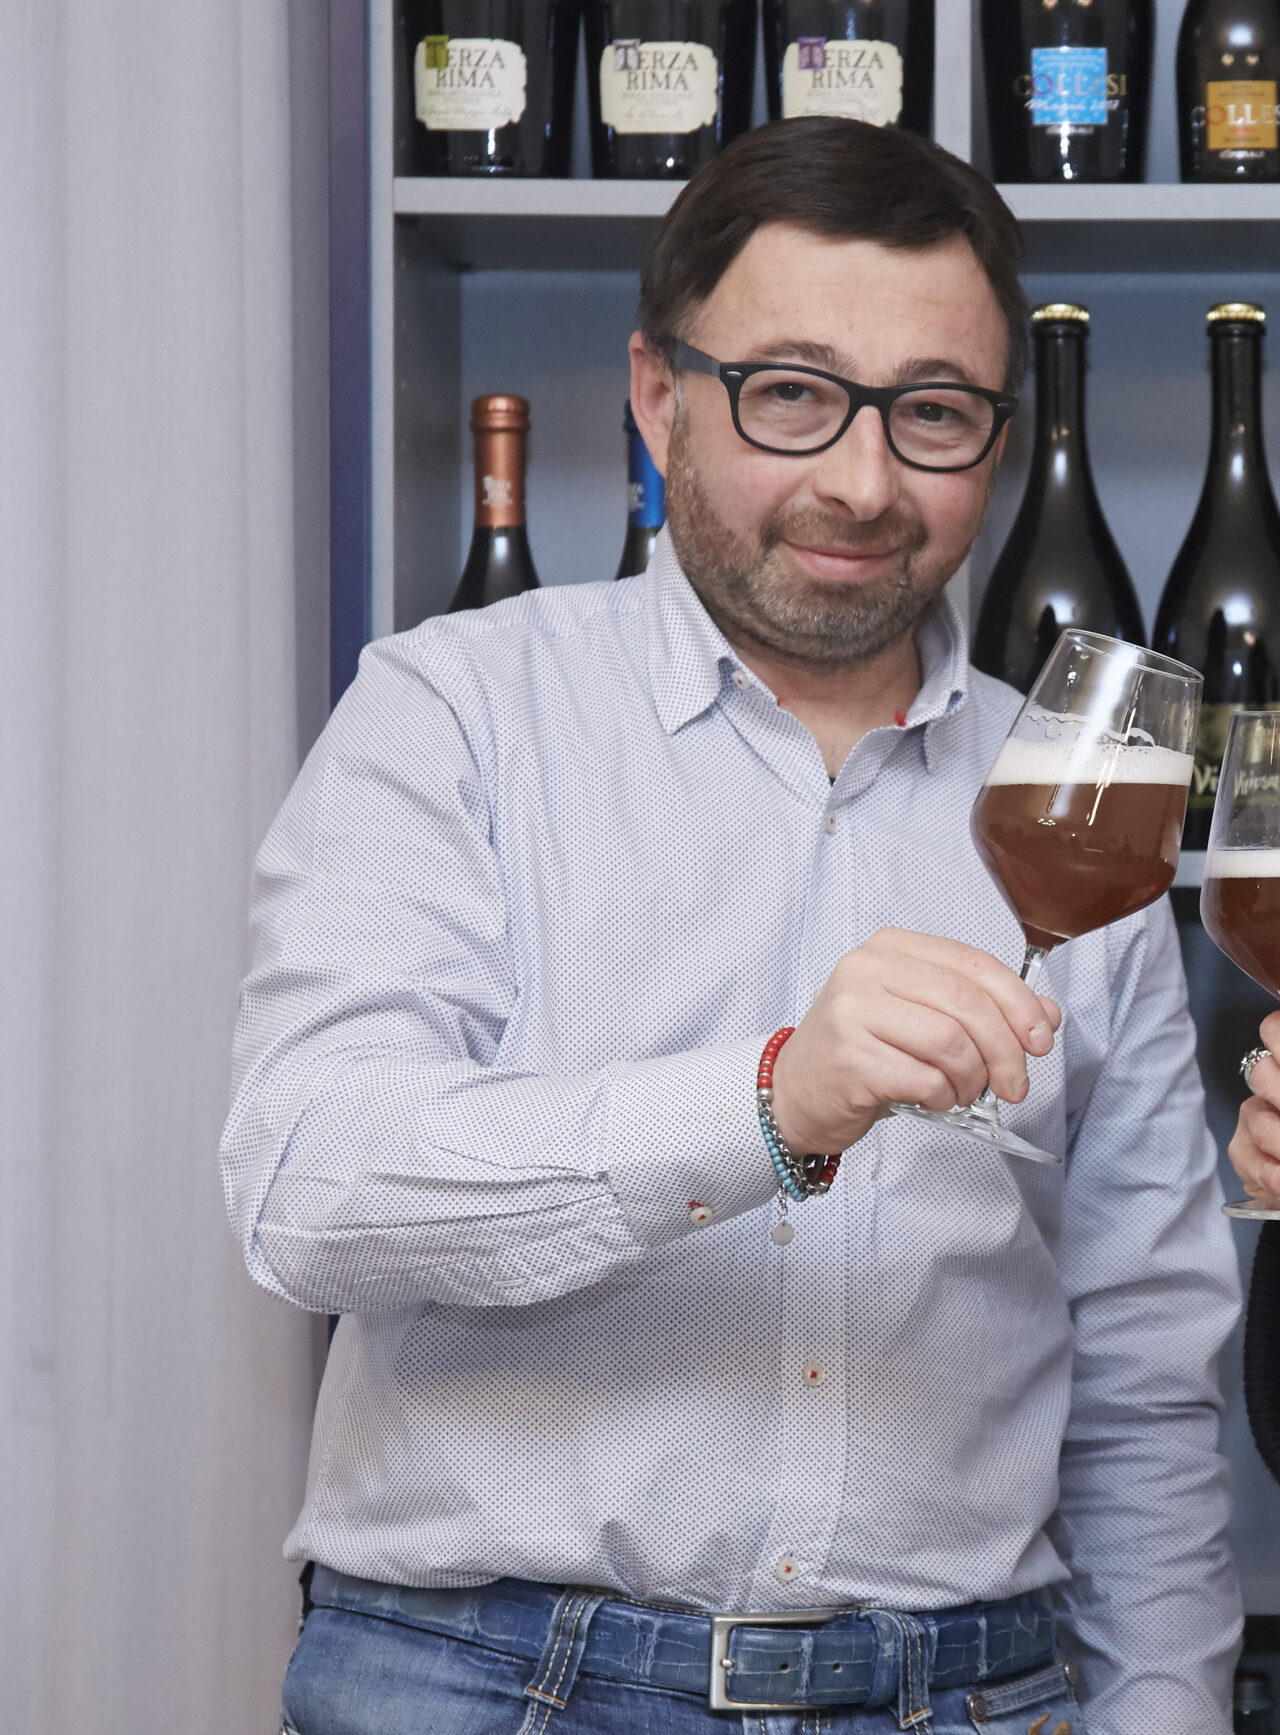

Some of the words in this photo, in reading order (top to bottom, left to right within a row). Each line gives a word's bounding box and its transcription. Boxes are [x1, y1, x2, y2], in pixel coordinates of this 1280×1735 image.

[426, 41, 505, 69] TERZA
[615, 43, 698, 71] TERZA
[799, 43, 883, 70] TERZA
[436, 69, 495, 88] RIMA
[626, 71, 689, 90] RIMA
[812, 70, 874, 88] RIMA
